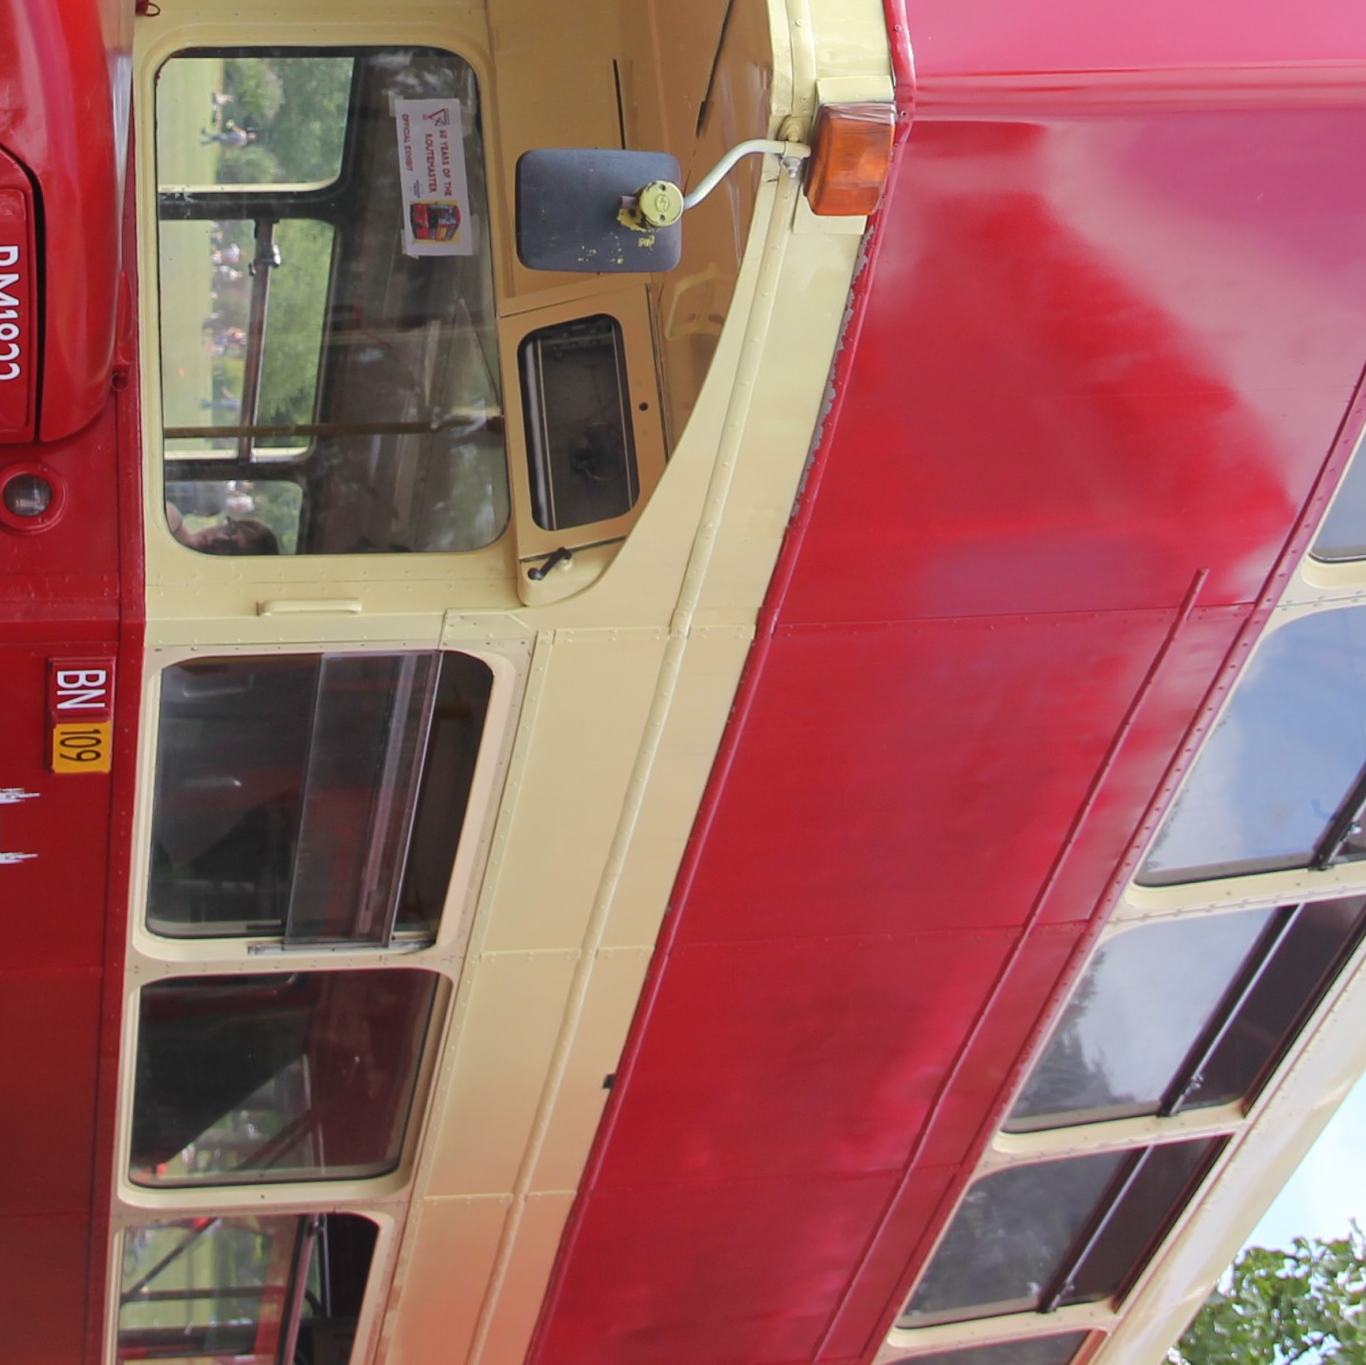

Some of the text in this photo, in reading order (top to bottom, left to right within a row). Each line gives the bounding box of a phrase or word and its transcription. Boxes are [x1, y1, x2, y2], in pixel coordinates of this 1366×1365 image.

[402, 114, 413, 171] OFFICIAL EXHIBIT
[425, 134, 437, 193] ROUTEMASTER
[439, 130, 452, 196] 60 YEARS OF THE
[55, 669, 107, 762] BN 109
